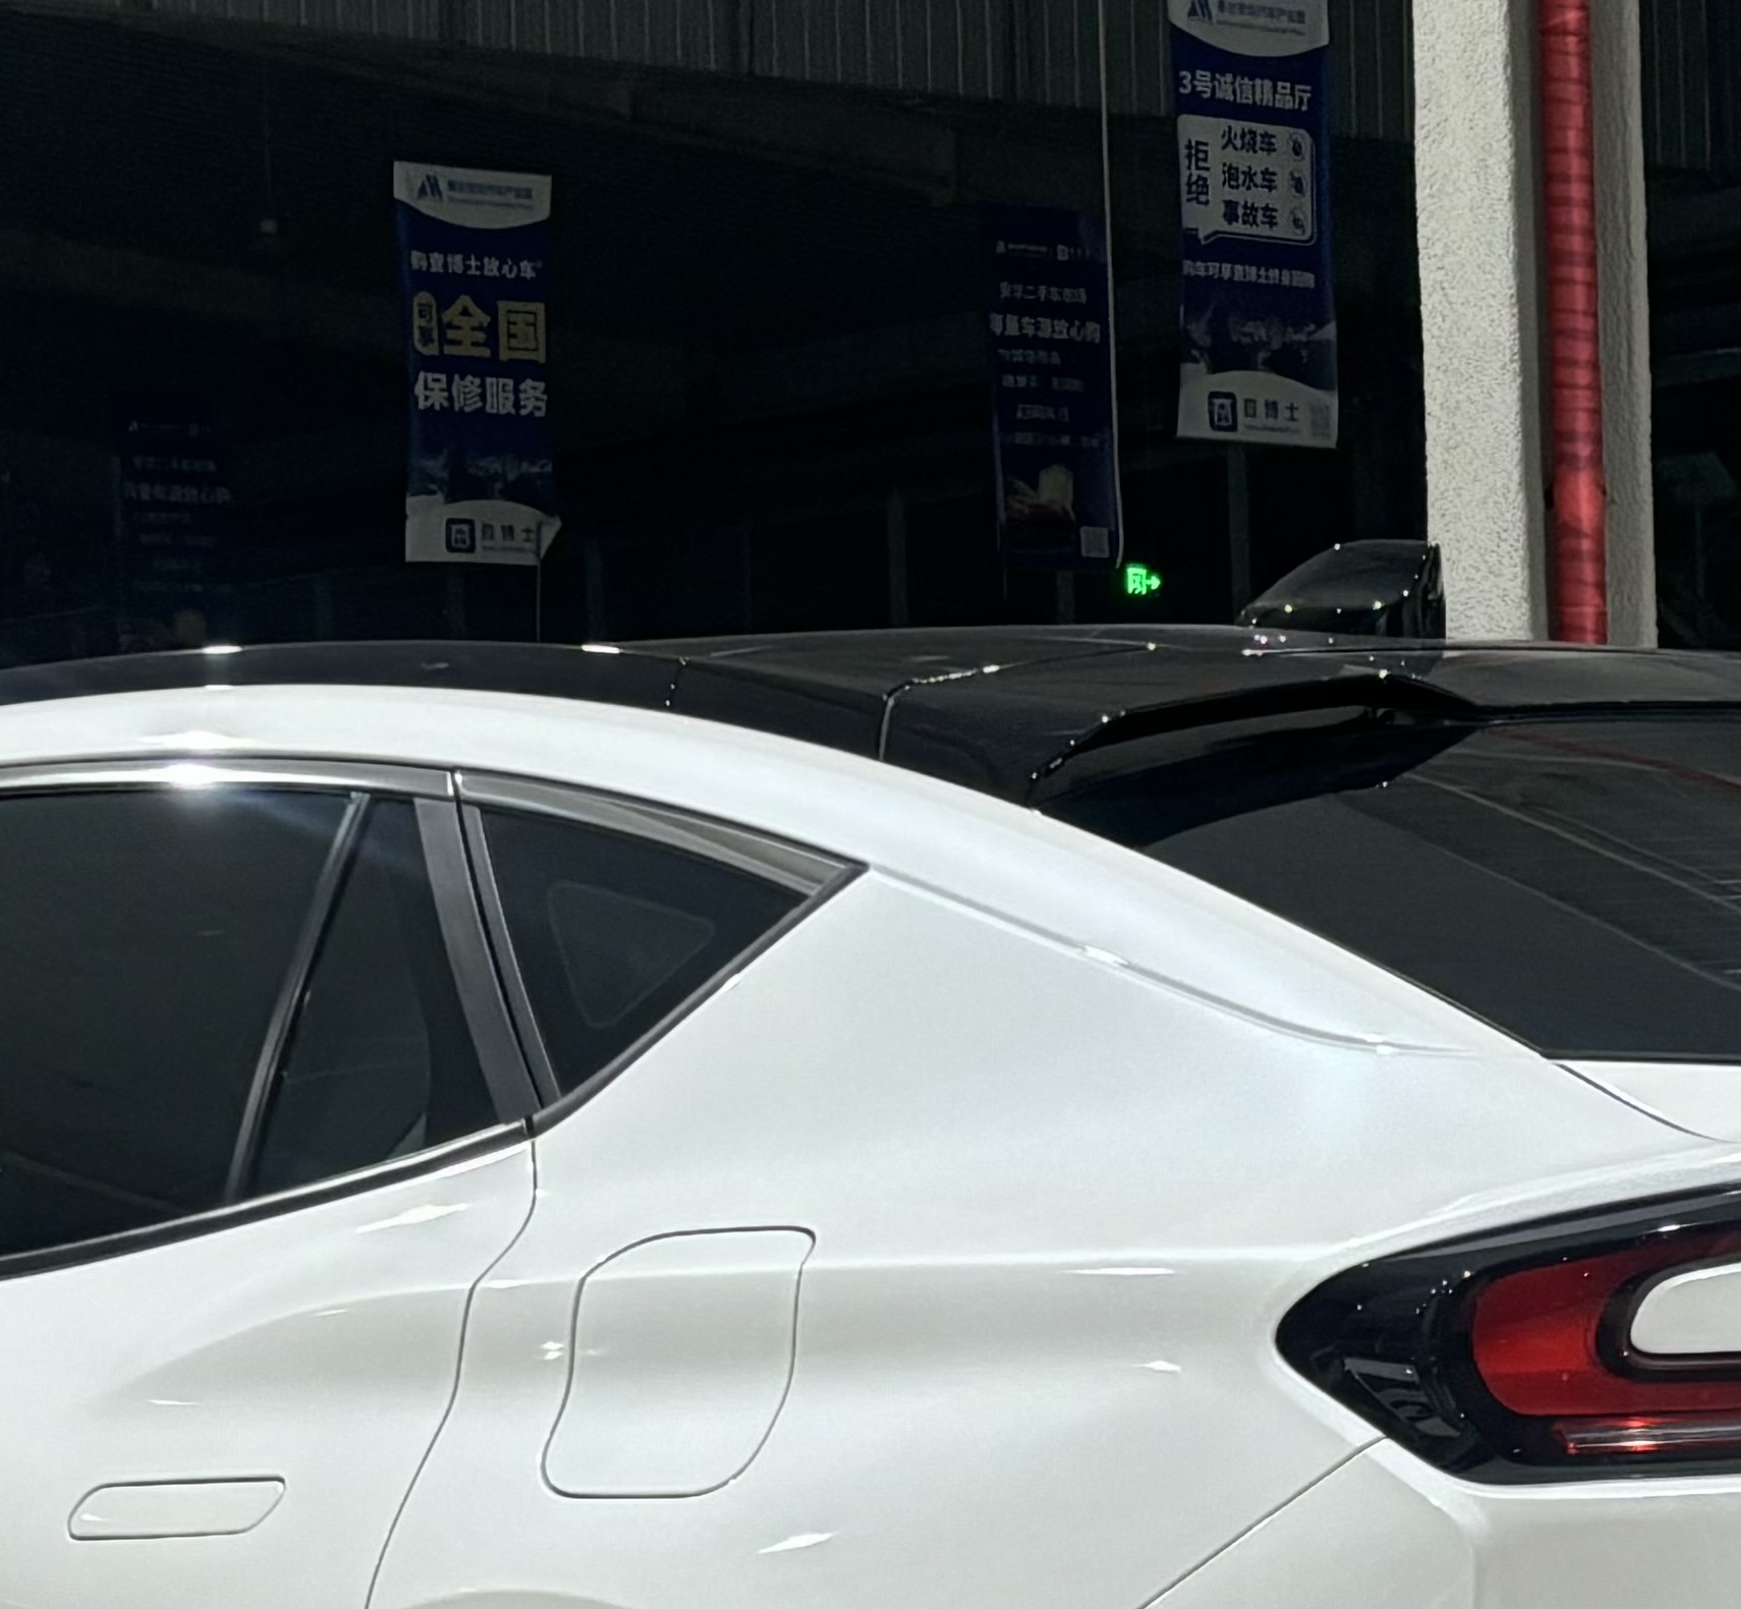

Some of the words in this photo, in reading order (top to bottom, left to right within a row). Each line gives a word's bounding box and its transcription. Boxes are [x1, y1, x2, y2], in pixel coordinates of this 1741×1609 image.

[1221, 126, 1278, 156] 火烧车
[1184, 139, 1211, 207] 拒绝
[440, 293, 548, 365] 全国
[413, 370, 549, 418] 保修服务
